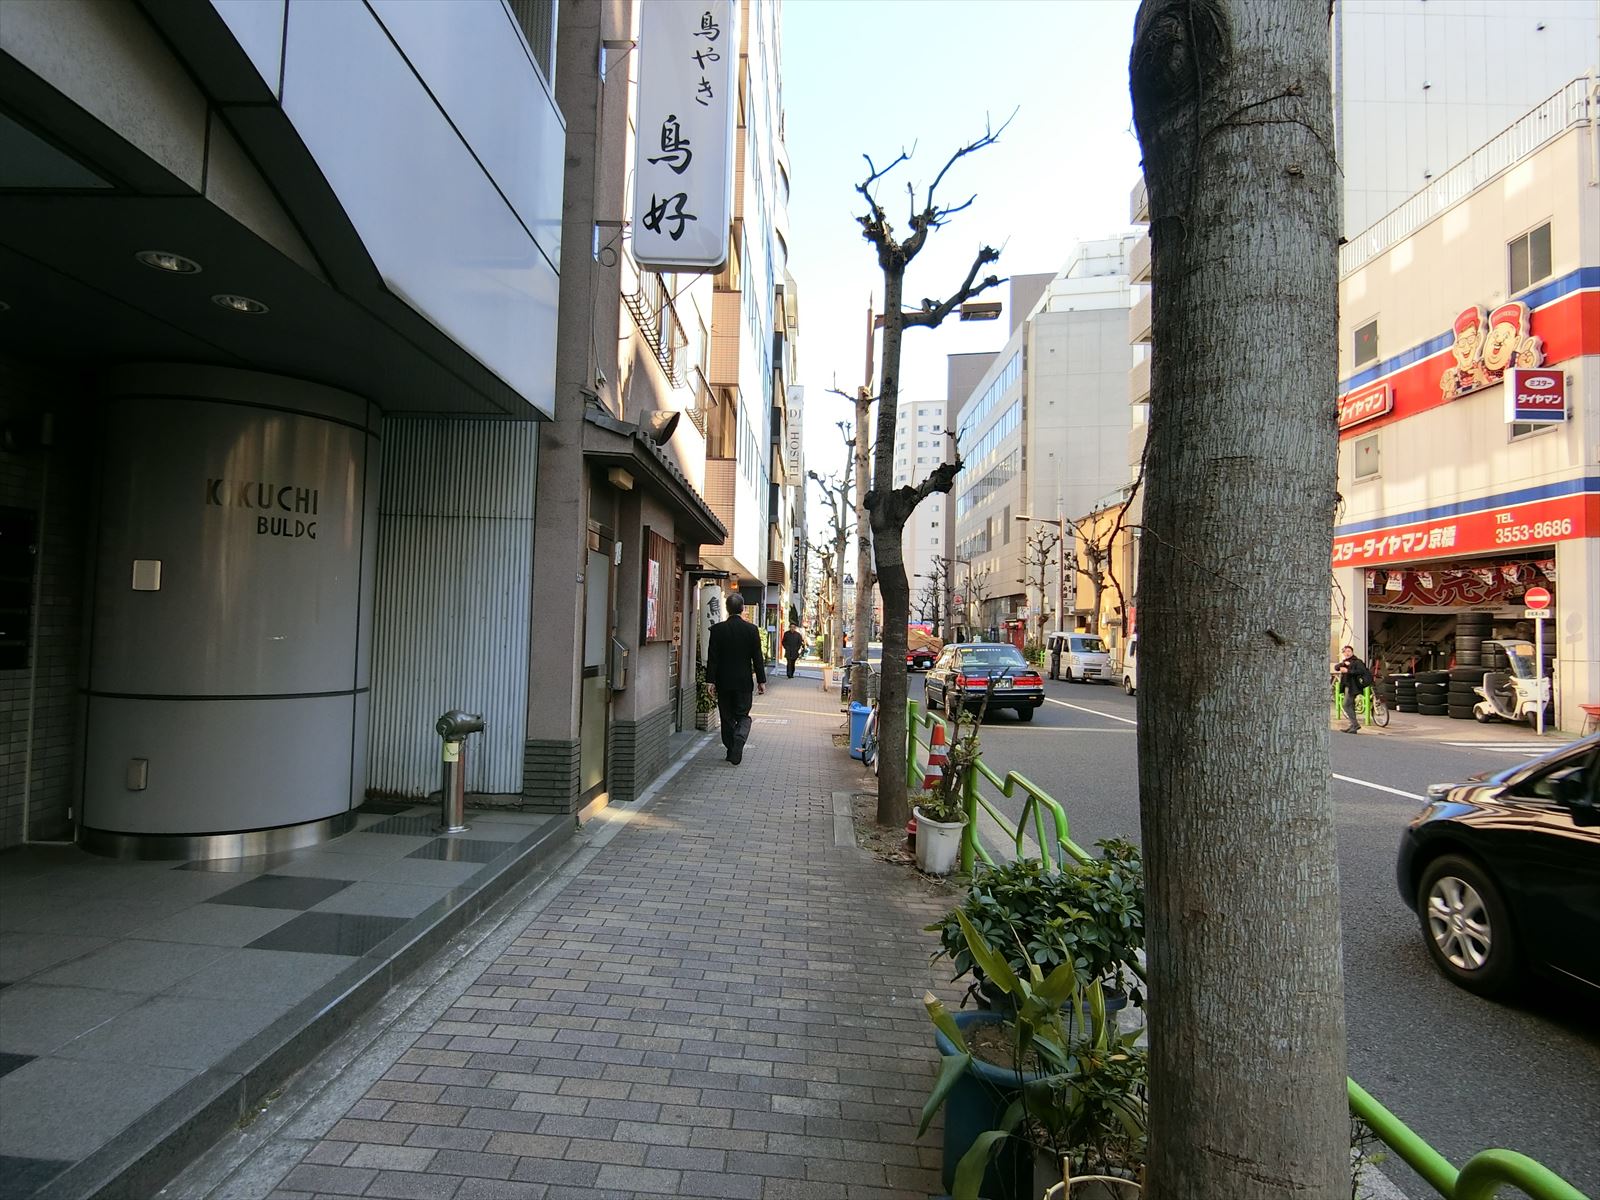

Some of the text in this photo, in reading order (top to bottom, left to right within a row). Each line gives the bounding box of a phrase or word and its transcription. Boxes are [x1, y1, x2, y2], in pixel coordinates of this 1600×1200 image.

[642, 114, 697, 241] 鳥好
[1517, 393, 1562, 404] タイヤマン
[789, 431, 800, 480] HOSTEL
[256, 516, 317, 540] BULDG
[1495, 512, 1514, 524] TEL
[1495, 518, 1572, 544] 3553-8686
